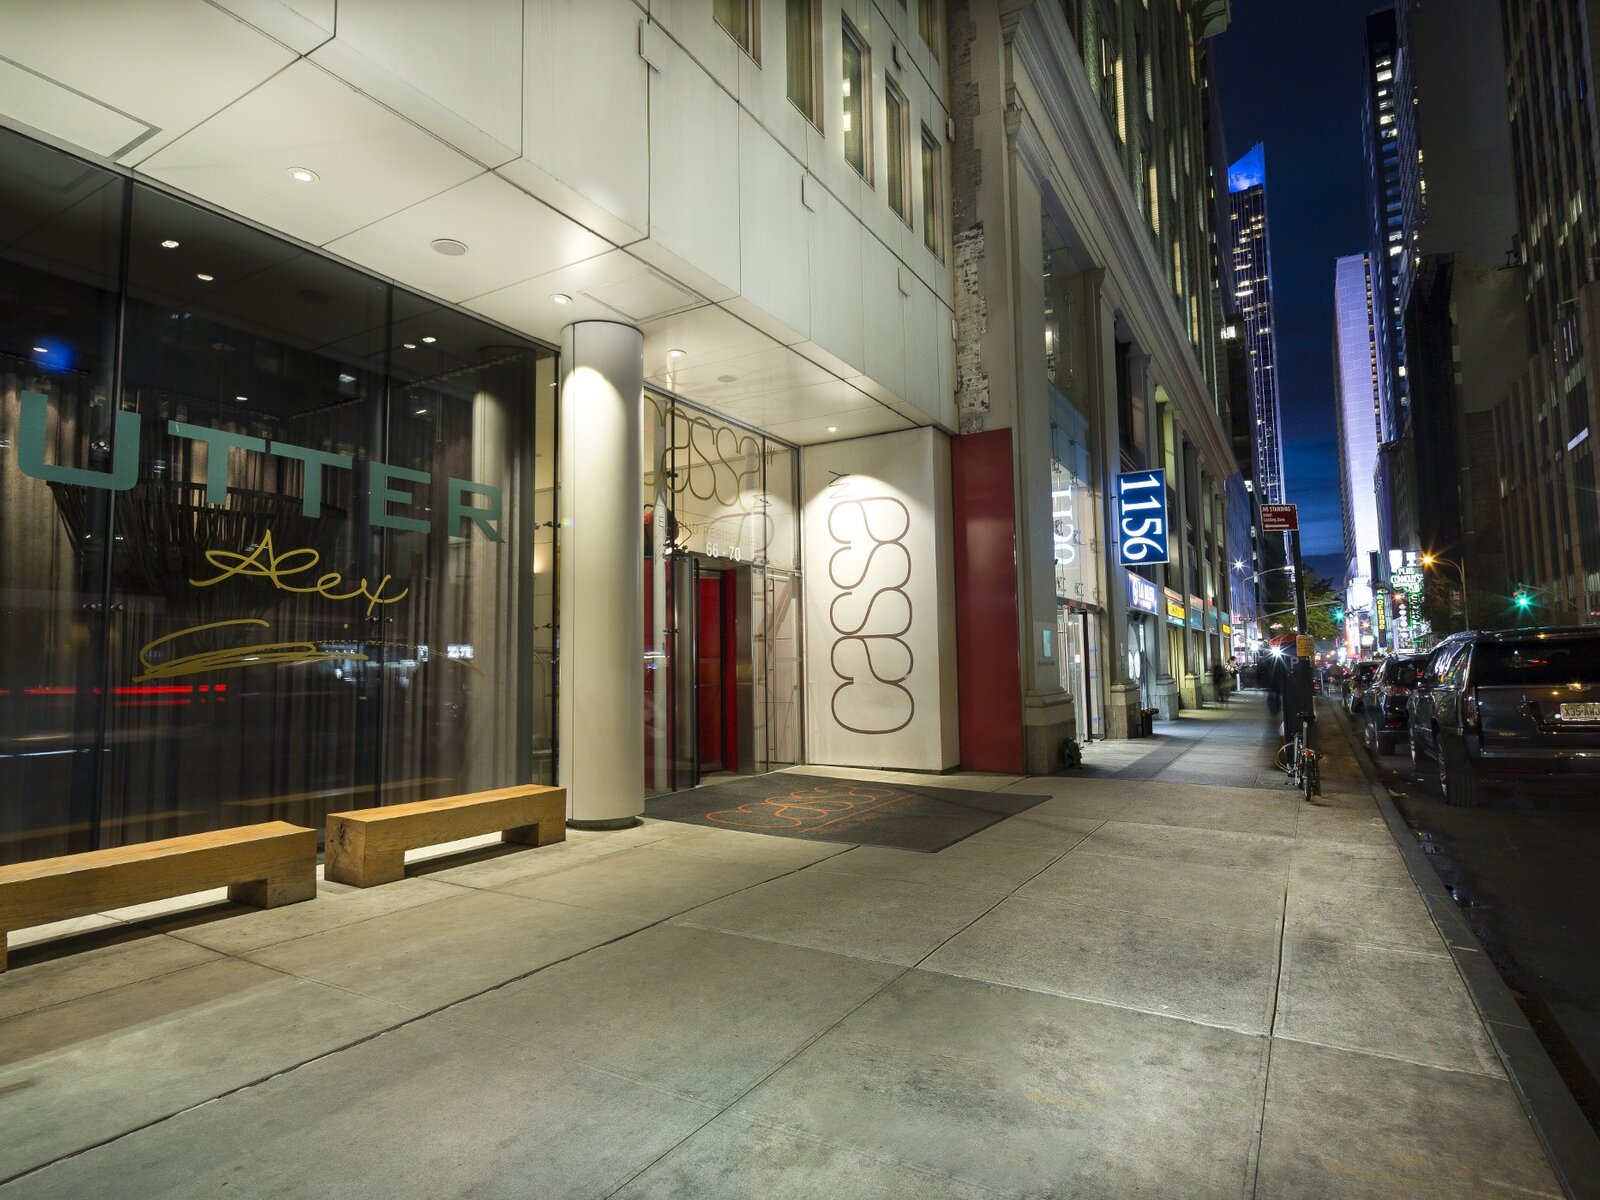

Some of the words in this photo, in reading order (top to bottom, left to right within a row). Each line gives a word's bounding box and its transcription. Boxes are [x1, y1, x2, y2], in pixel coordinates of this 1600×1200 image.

[18, 390, 505, 543] UTTER
[706, 542, 719, 558] 66
[728, 546, 741, 561] 70
[1120, 474, 1163, 559] 1156
[189, 529, 408, 616] Alex
[829, 497, 914, 734] cassa
